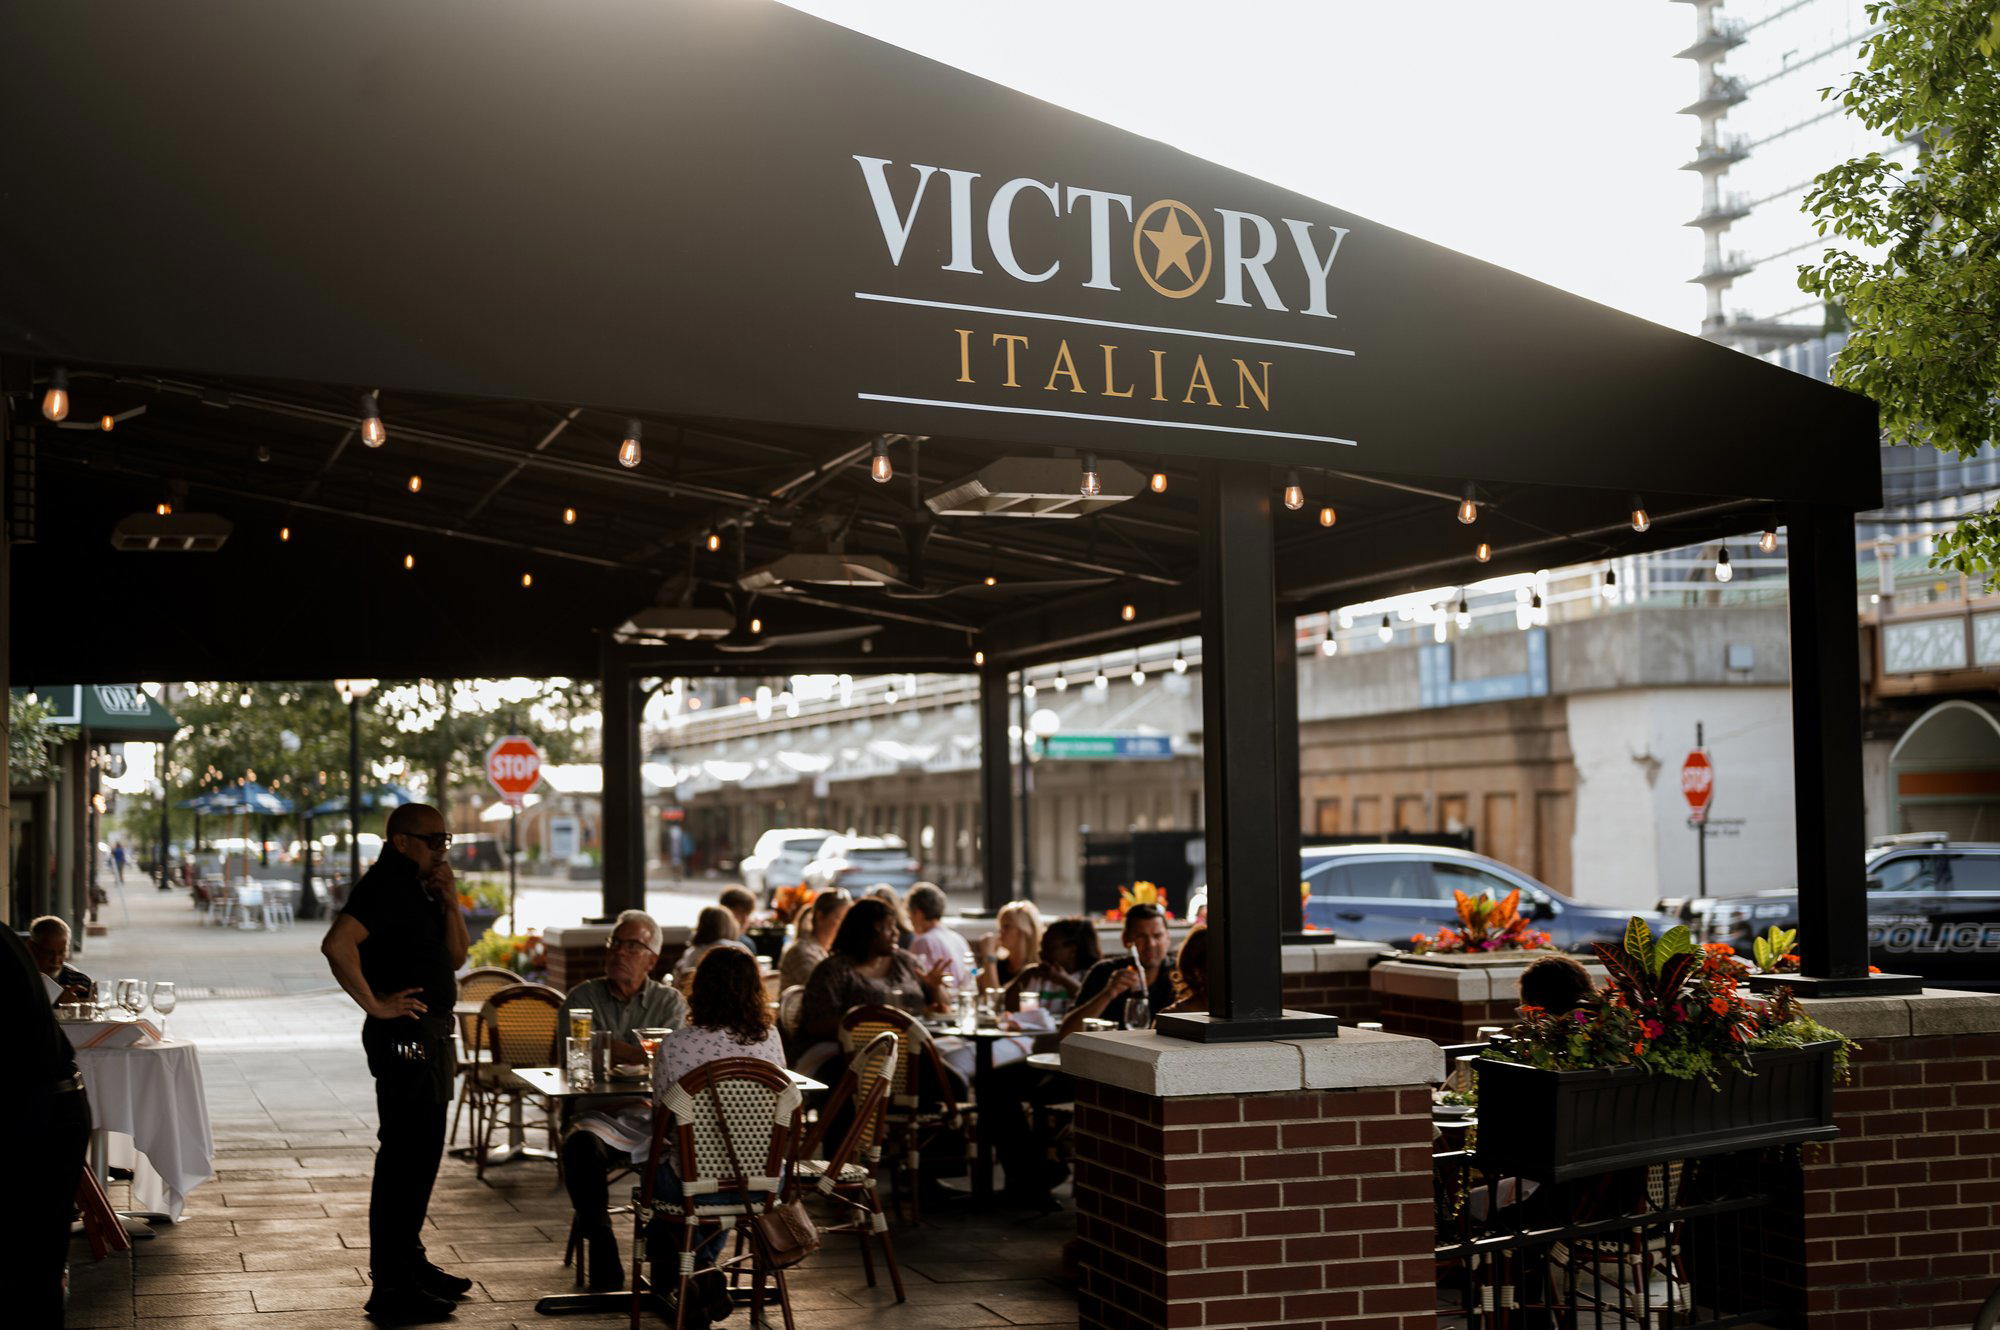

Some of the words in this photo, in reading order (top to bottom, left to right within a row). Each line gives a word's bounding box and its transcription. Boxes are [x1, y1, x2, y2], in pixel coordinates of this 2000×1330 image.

[852, 154, 1350, 319] VICTORY
[954, 329, 1274, 412] ITALIAN
[492, 754, 539, 780] STOP
[1681, 767, 1712, 792] STOP
